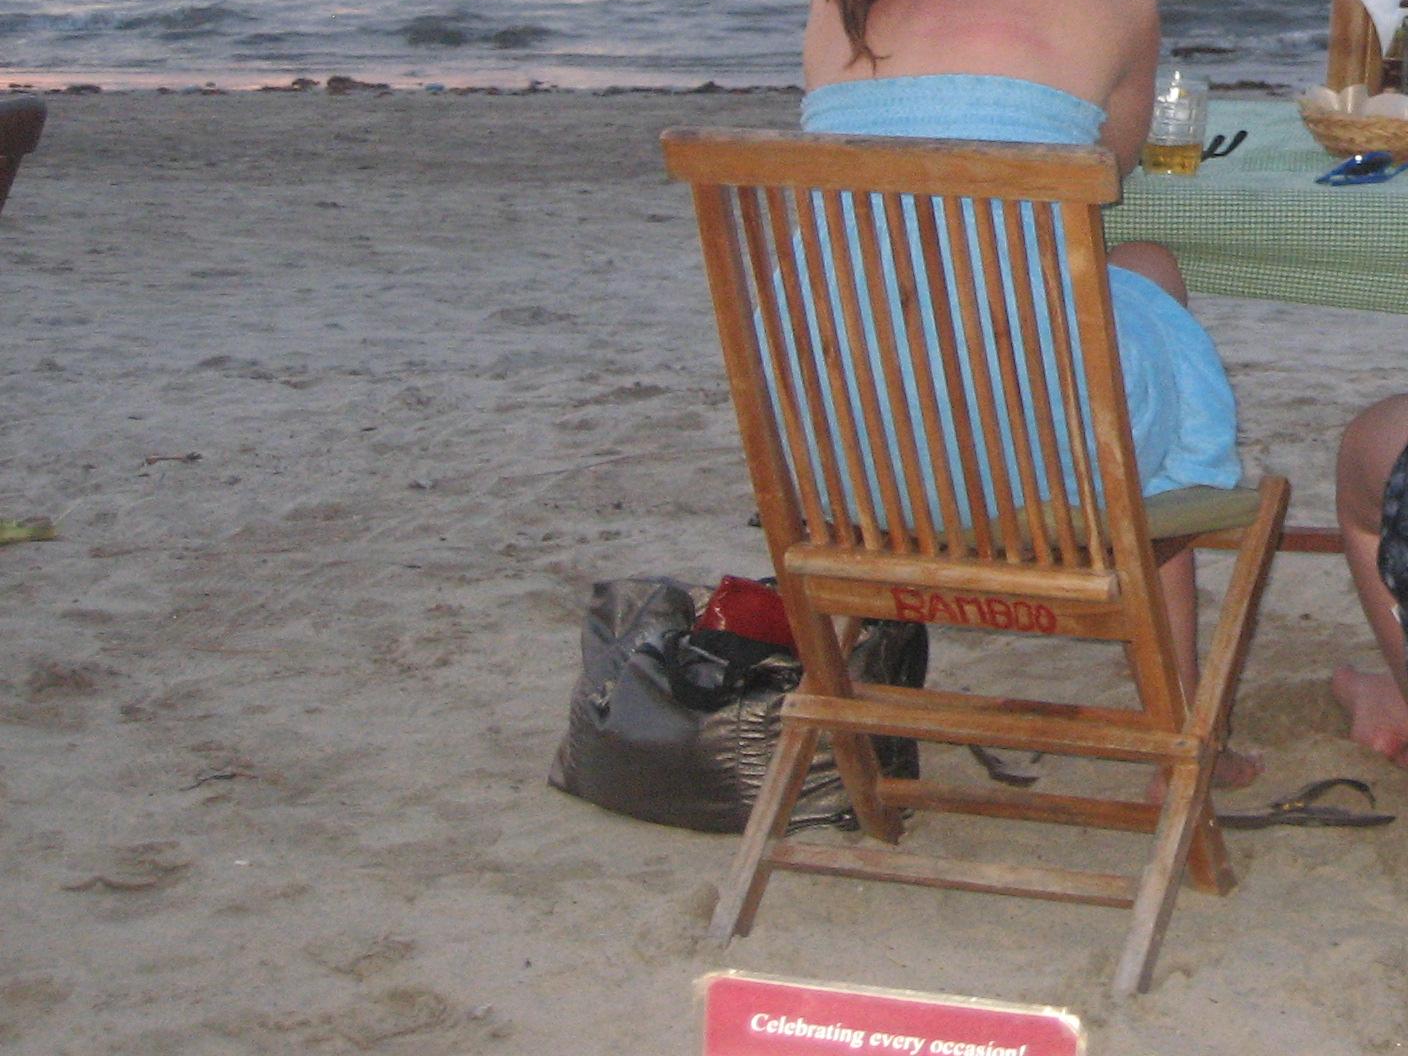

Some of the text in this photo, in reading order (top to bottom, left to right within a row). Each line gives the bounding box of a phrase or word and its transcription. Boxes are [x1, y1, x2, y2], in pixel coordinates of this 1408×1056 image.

[890, 587, 1057, 633] BAMBOO
[750, 1013, 1028, 1056] Celebrating every occasion!
